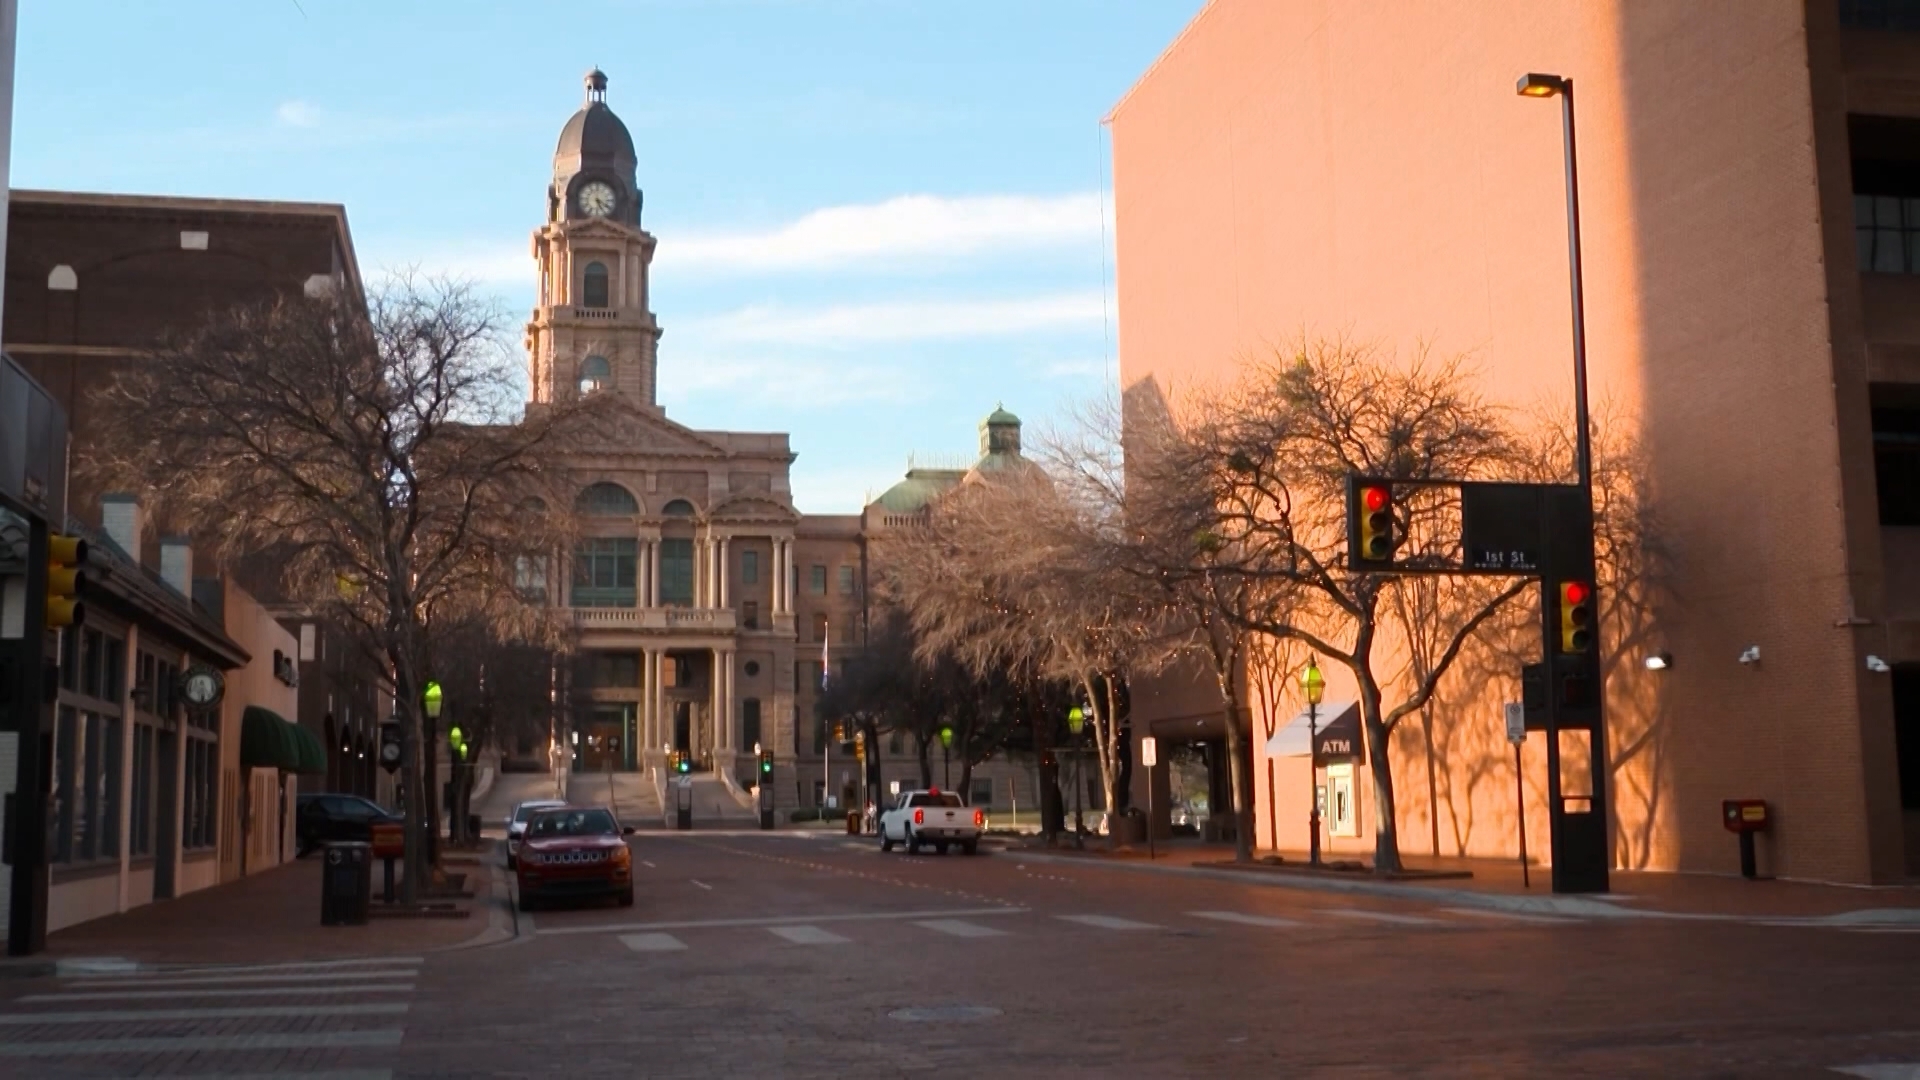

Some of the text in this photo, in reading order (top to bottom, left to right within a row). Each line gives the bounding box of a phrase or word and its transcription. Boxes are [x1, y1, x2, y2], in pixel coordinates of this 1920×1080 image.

[1485, 550, 1525, 562] 1st St
[1321, 739, 1351, 754] ATM
